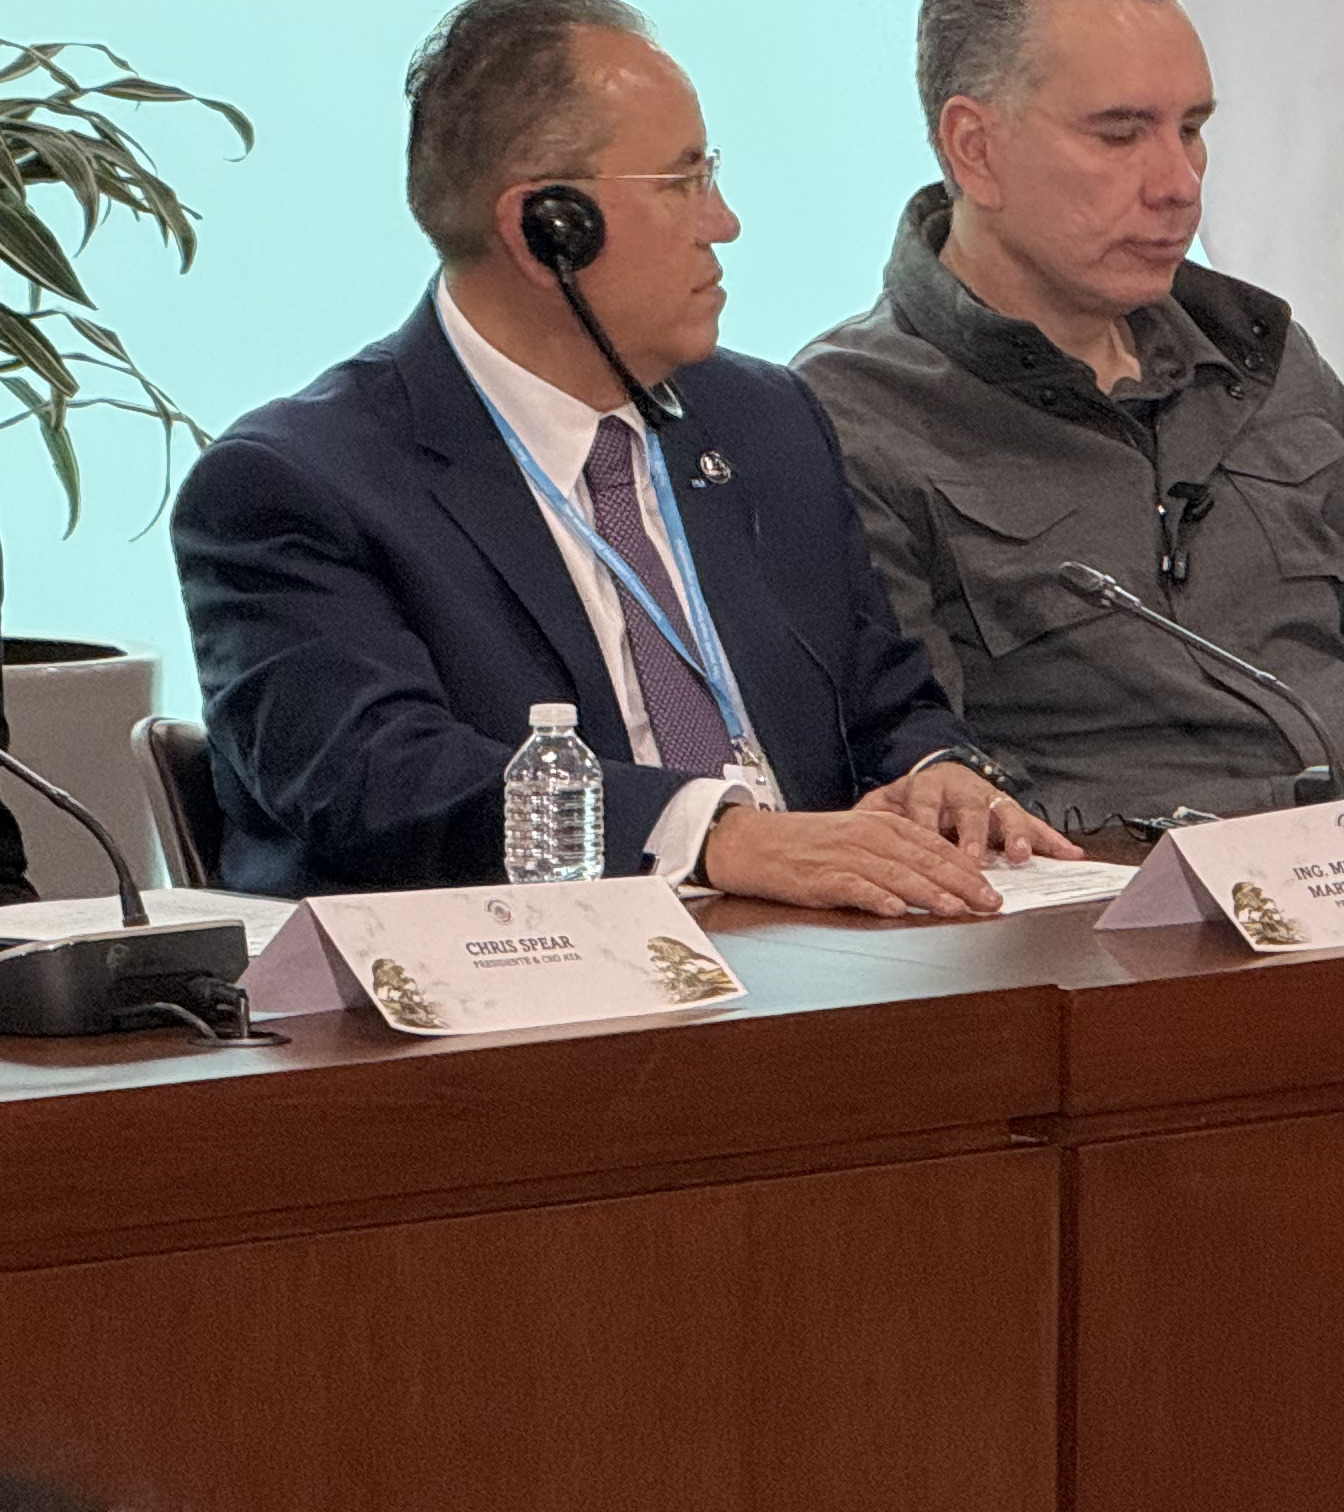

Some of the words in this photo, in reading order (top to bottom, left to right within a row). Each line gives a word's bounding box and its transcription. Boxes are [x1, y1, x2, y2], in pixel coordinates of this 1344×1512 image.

[1292, 864, 1329, 881] ING.
[465, 939, 518, 956] CHRIS
[518, 935, 575, 952] SPEAR
